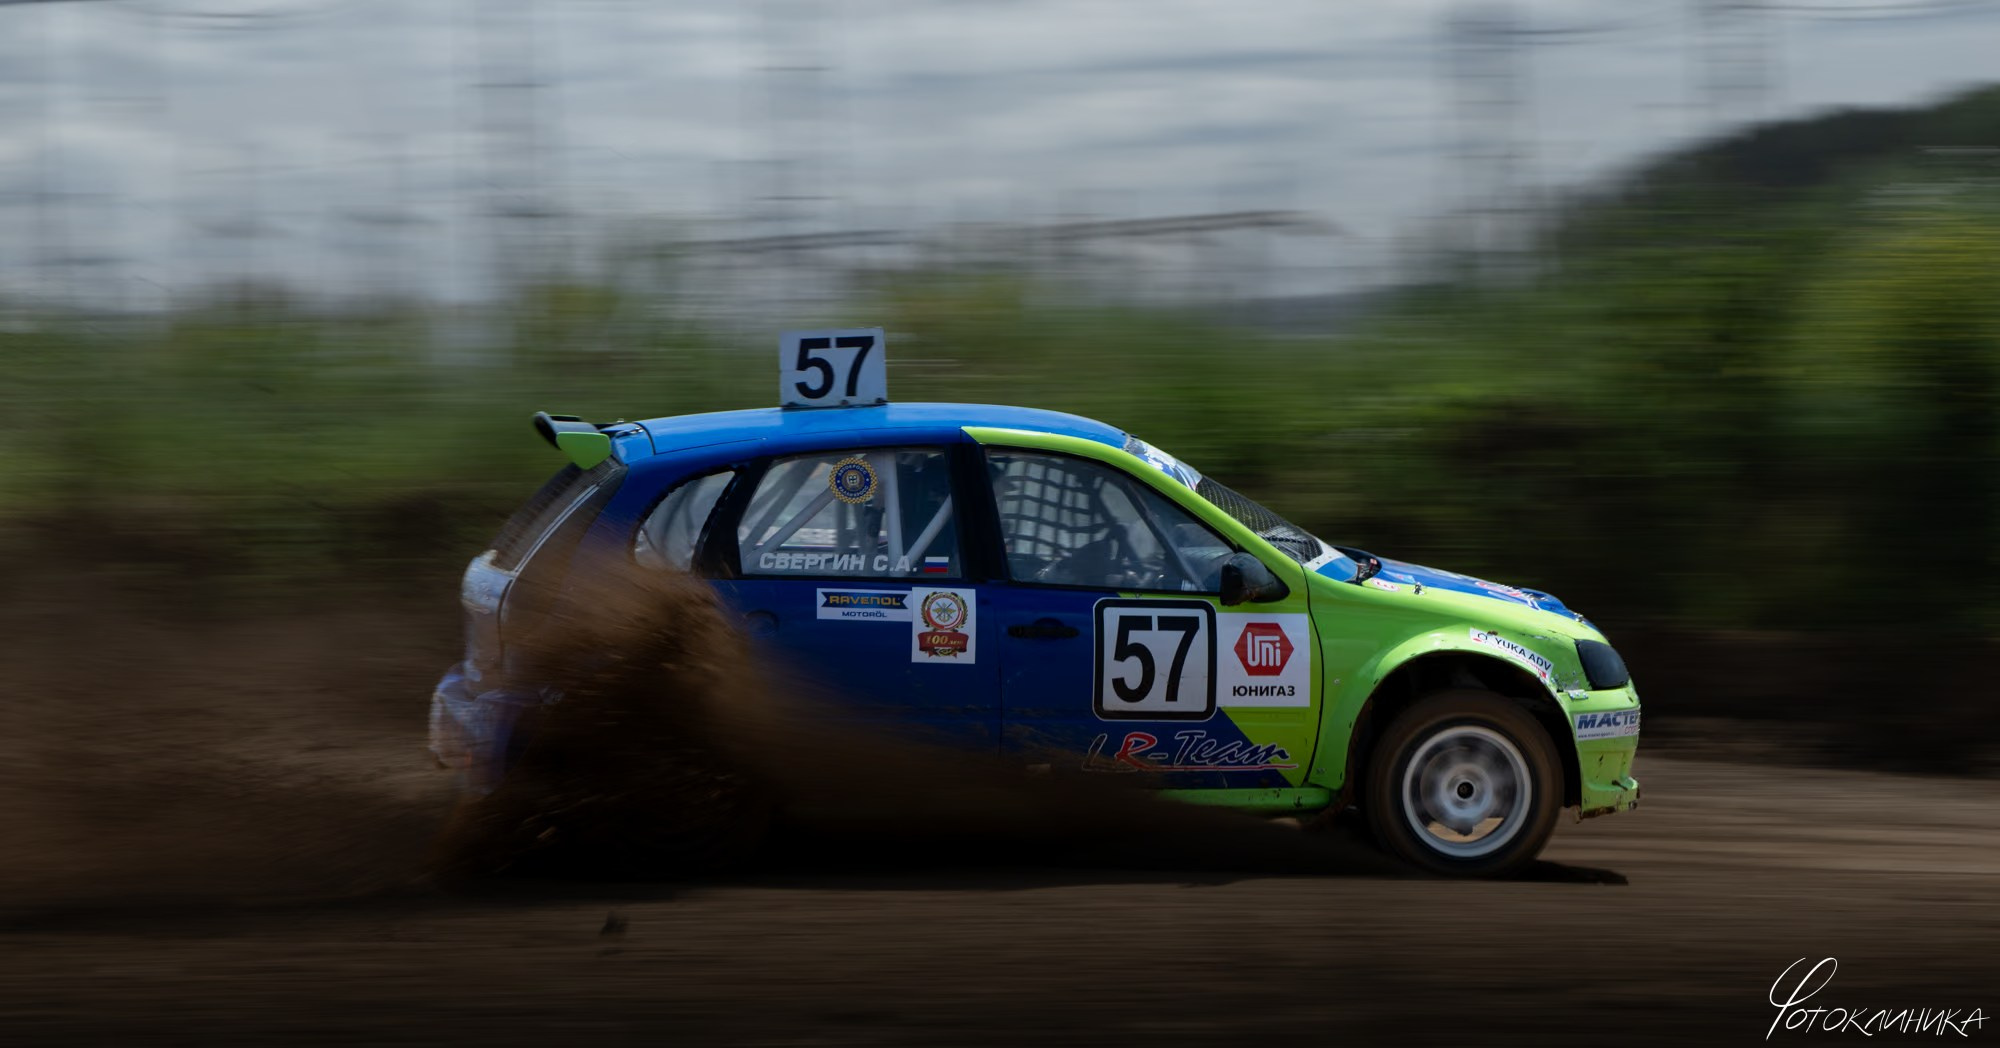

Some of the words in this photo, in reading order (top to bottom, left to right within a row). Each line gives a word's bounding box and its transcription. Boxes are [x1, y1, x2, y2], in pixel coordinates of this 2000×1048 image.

[795, 336, 874, 399] 57
[759, 552, 865, 571] СВЕРГИН
[872, 555, 918, 572] С.А.
[829, 595, 901, 606] RAVENOL
[842, 610, 888, 618] MOTORÖL
[926, 635, 948, 645] 100
[1246, 631, 1281, 667] Uni
[1112, 615, 1200, 703] 57
[1495, 637, 1526, 658] YUKA
[1528, 653, 1552, 671] ADV
[1232, 685, 1295, 697] ЮНИГАЗ
